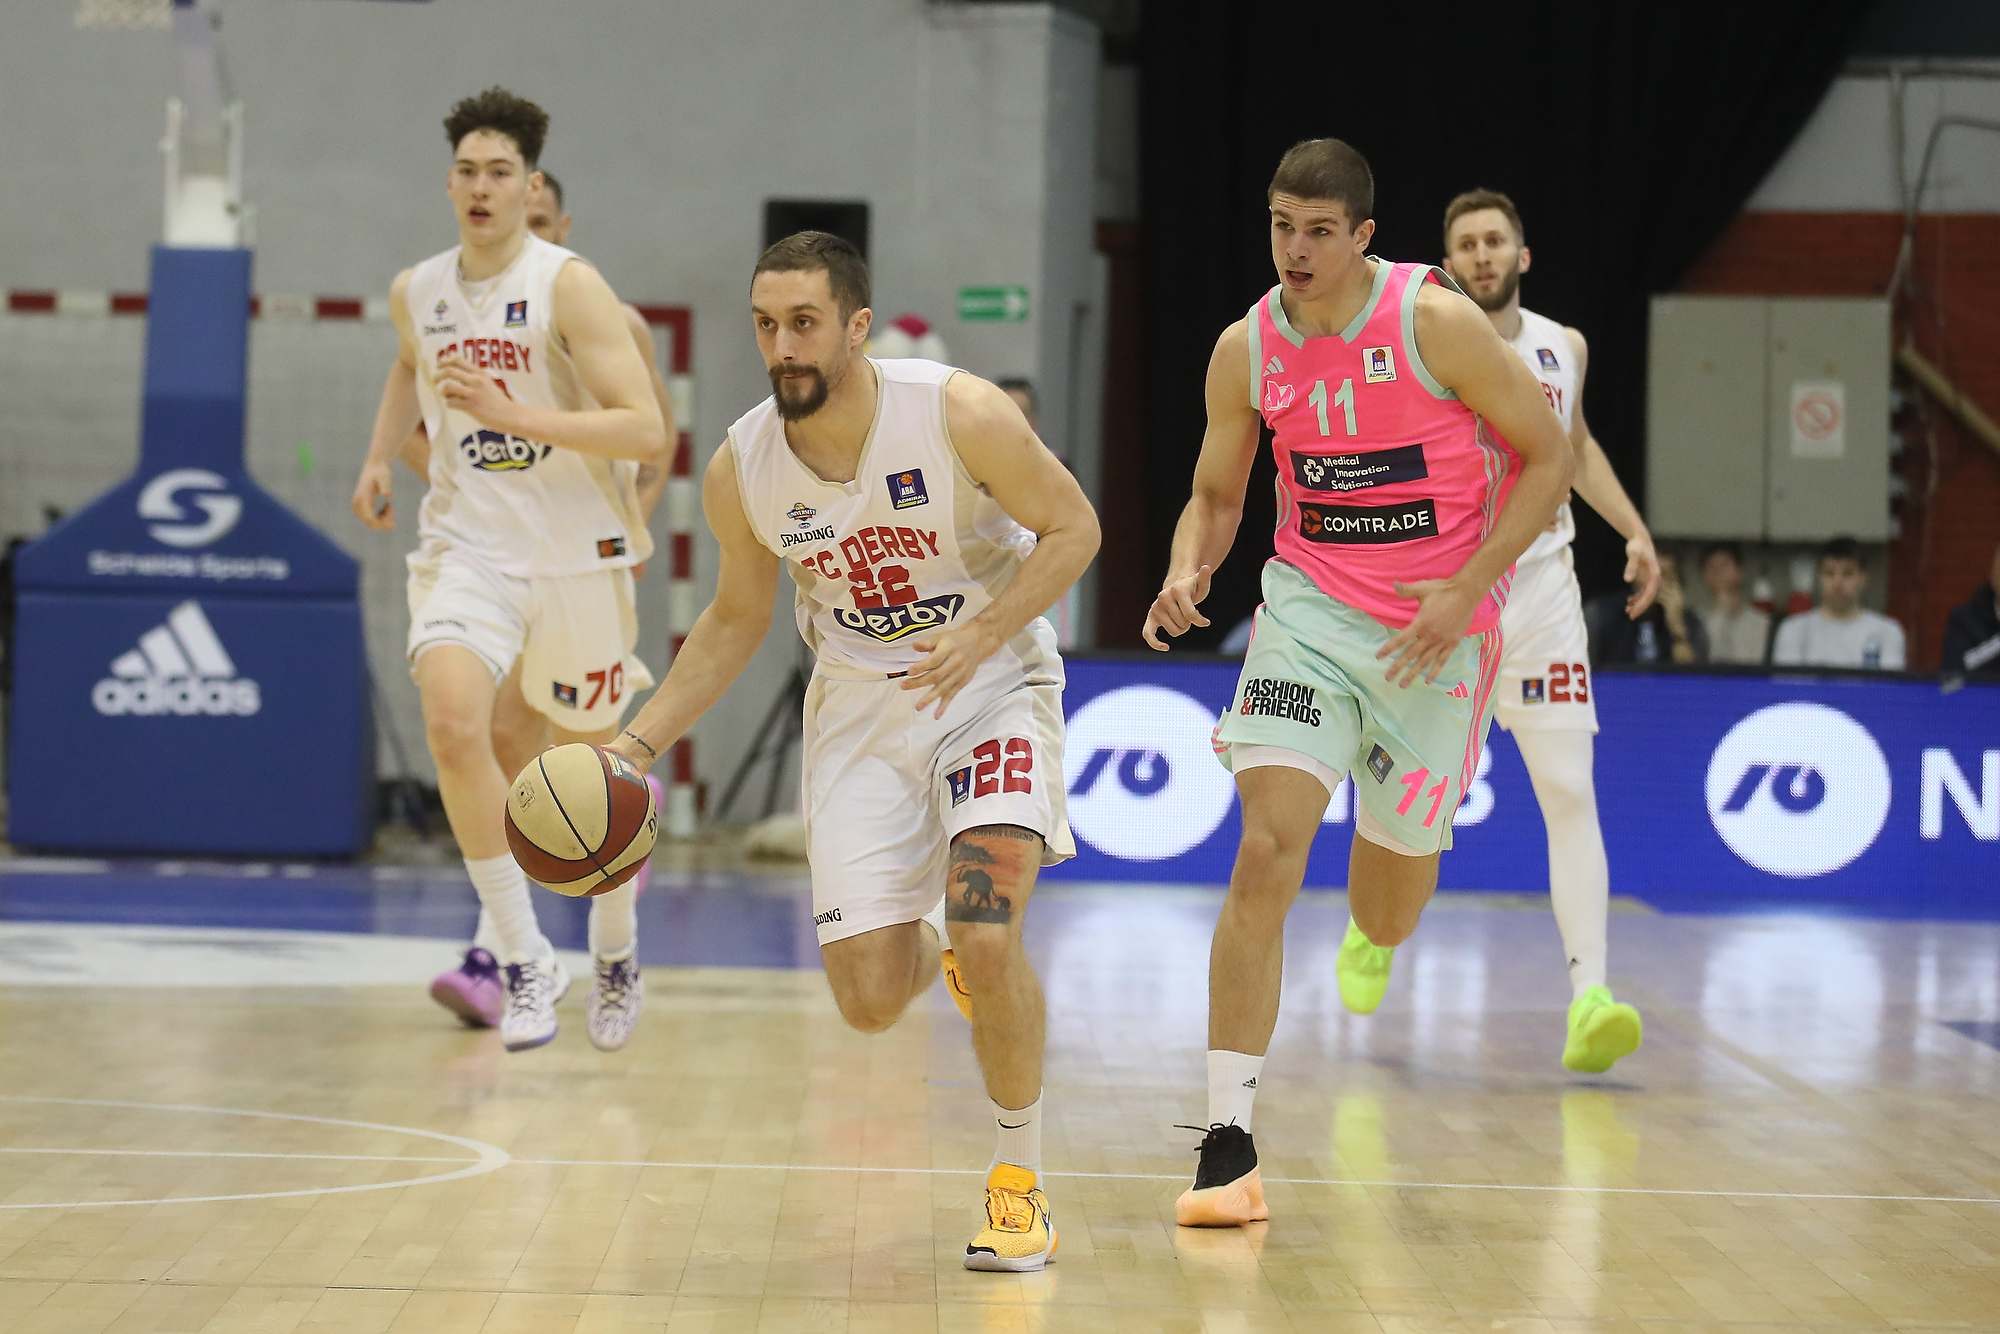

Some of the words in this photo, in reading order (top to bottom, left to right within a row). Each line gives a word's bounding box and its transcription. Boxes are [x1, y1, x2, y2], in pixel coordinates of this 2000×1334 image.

[463, 338, 531, 374] DERBY
[1309, 378, 1358, 436] 11
[1322, 455, 1360, 467] Medical
[1335, 464, 1390, 479] Innovation
[897, 494, 927, 505] ADMIRAL
[1331, 479, 1374, 491] Solutions
[780, 525, 836, 548] SPALDING
[1323, 509, 1430, 533] COMTRADE
[839, 525, 940, 572] DERBY
[847, 564, 919, 610] 22
[841, 596, 958, 634] derby
[91, 677, 262, 717] adidas
[584, 660, 624, 711] 70
[1243, 677, 1316, 707] FASHION
[1548, 663, 1589, 702] 23
[1240, 696, 1322, 728] &FRIENDS
[972, 737, 1033, 799] 22
[1395, 766, 1449, 828] 11
